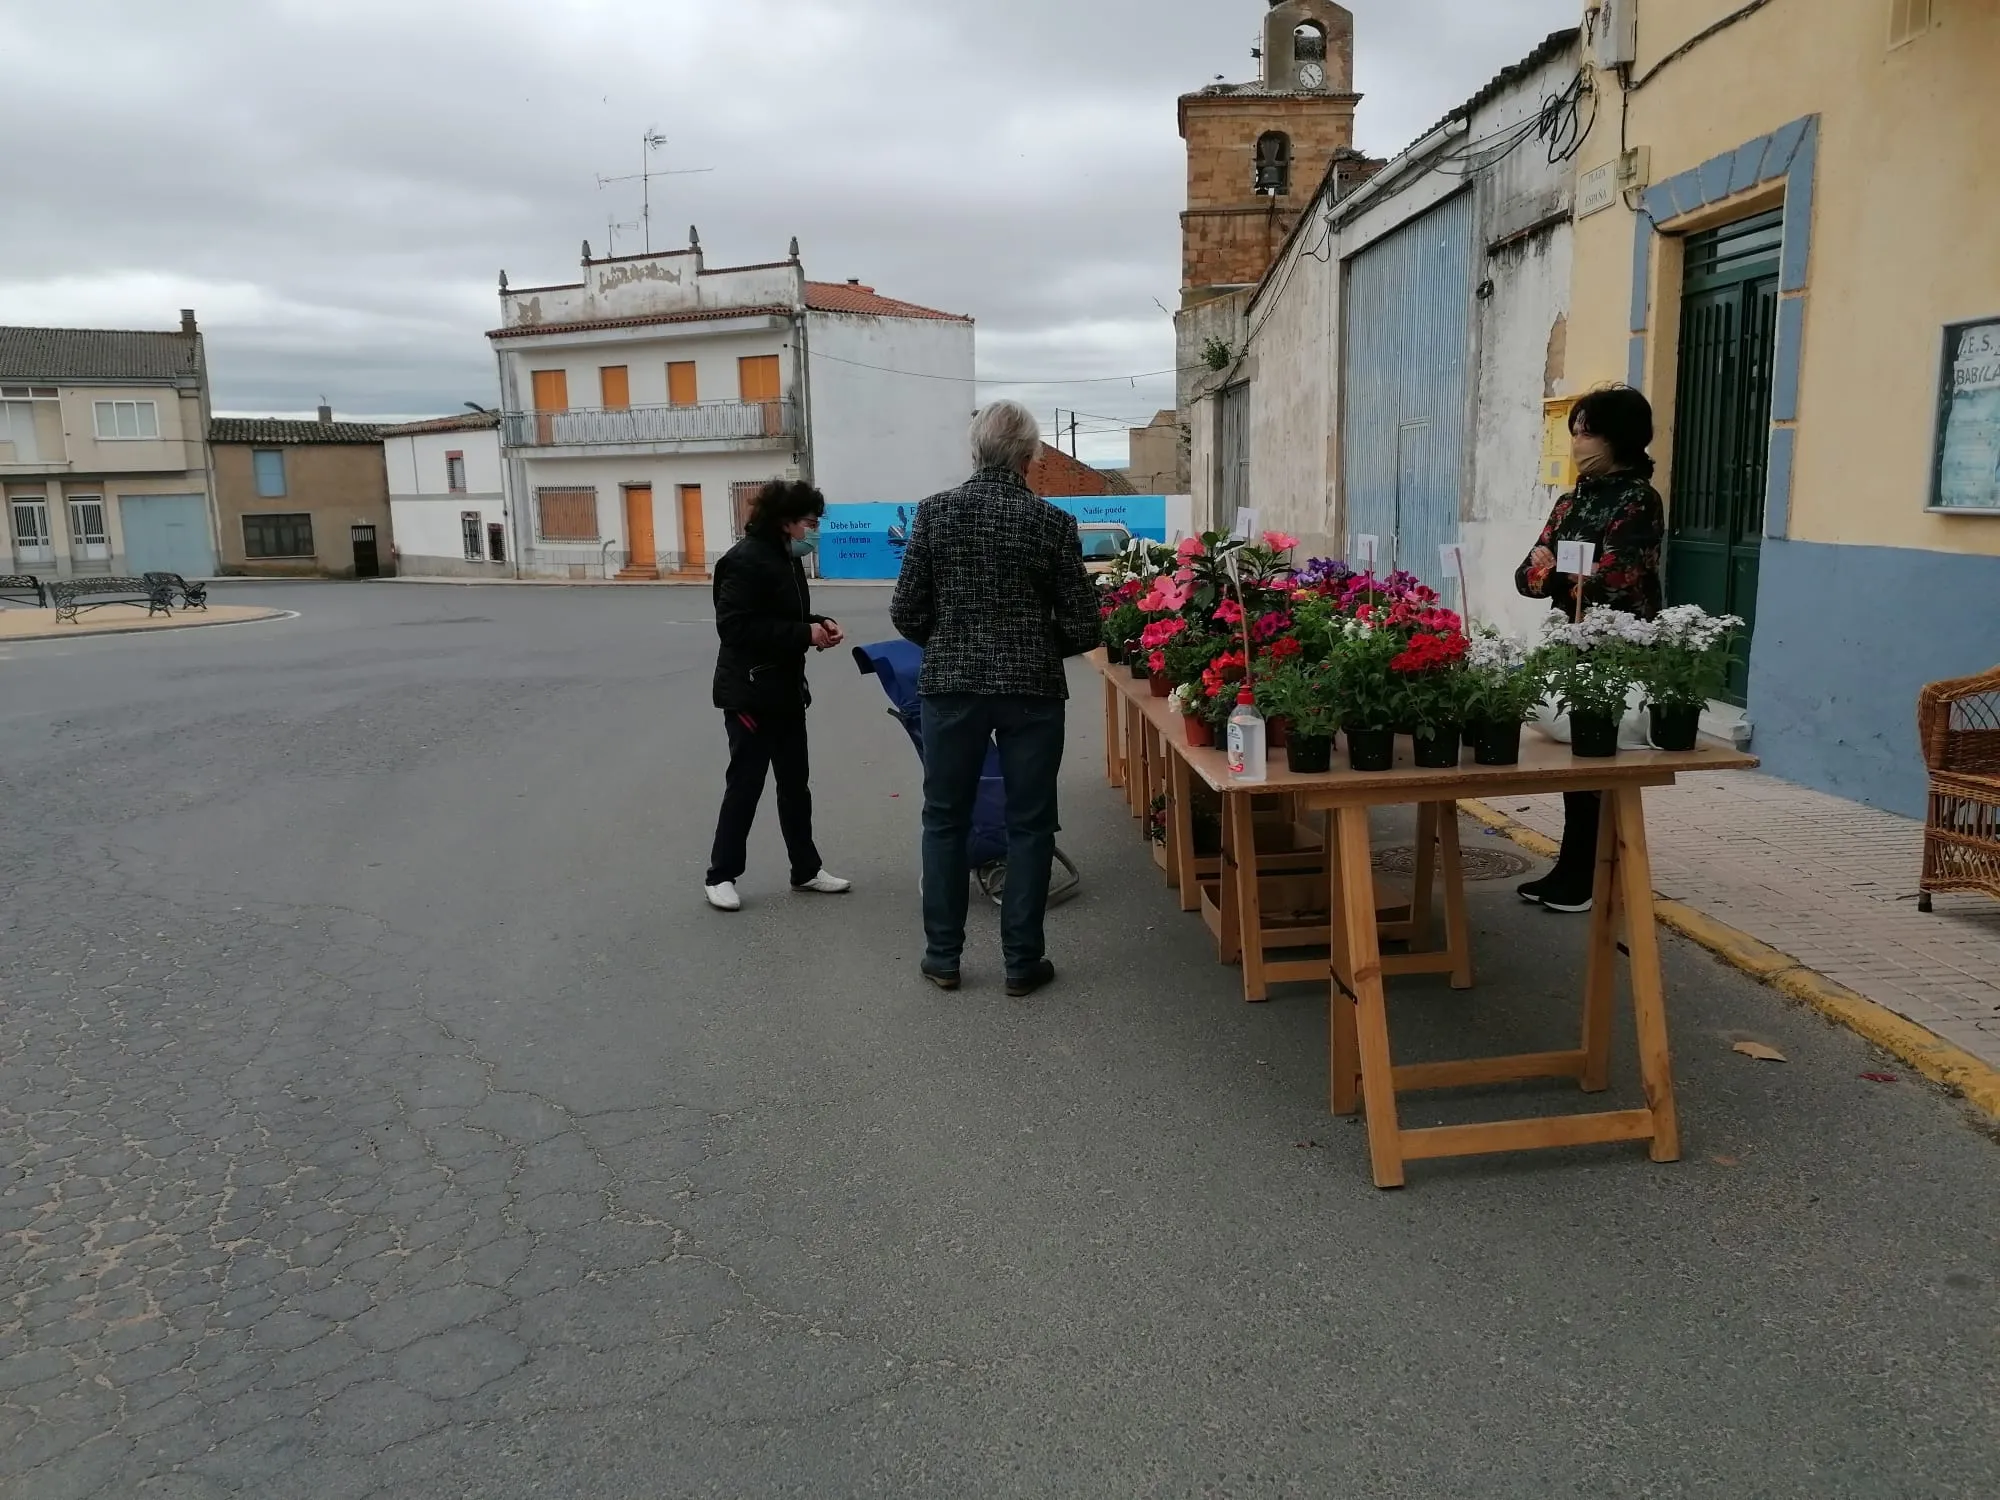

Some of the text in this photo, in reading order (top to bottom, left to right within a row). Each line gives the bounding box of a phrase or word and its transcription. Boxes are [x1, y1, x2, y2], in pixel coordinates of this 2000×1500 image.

[1083, 505, 1127, 516] Nadie puede
[830, 520, 871, 530] Debe haber
[849, 535, 871, 545] forma
[839, 549, 866, 559] de vivir
